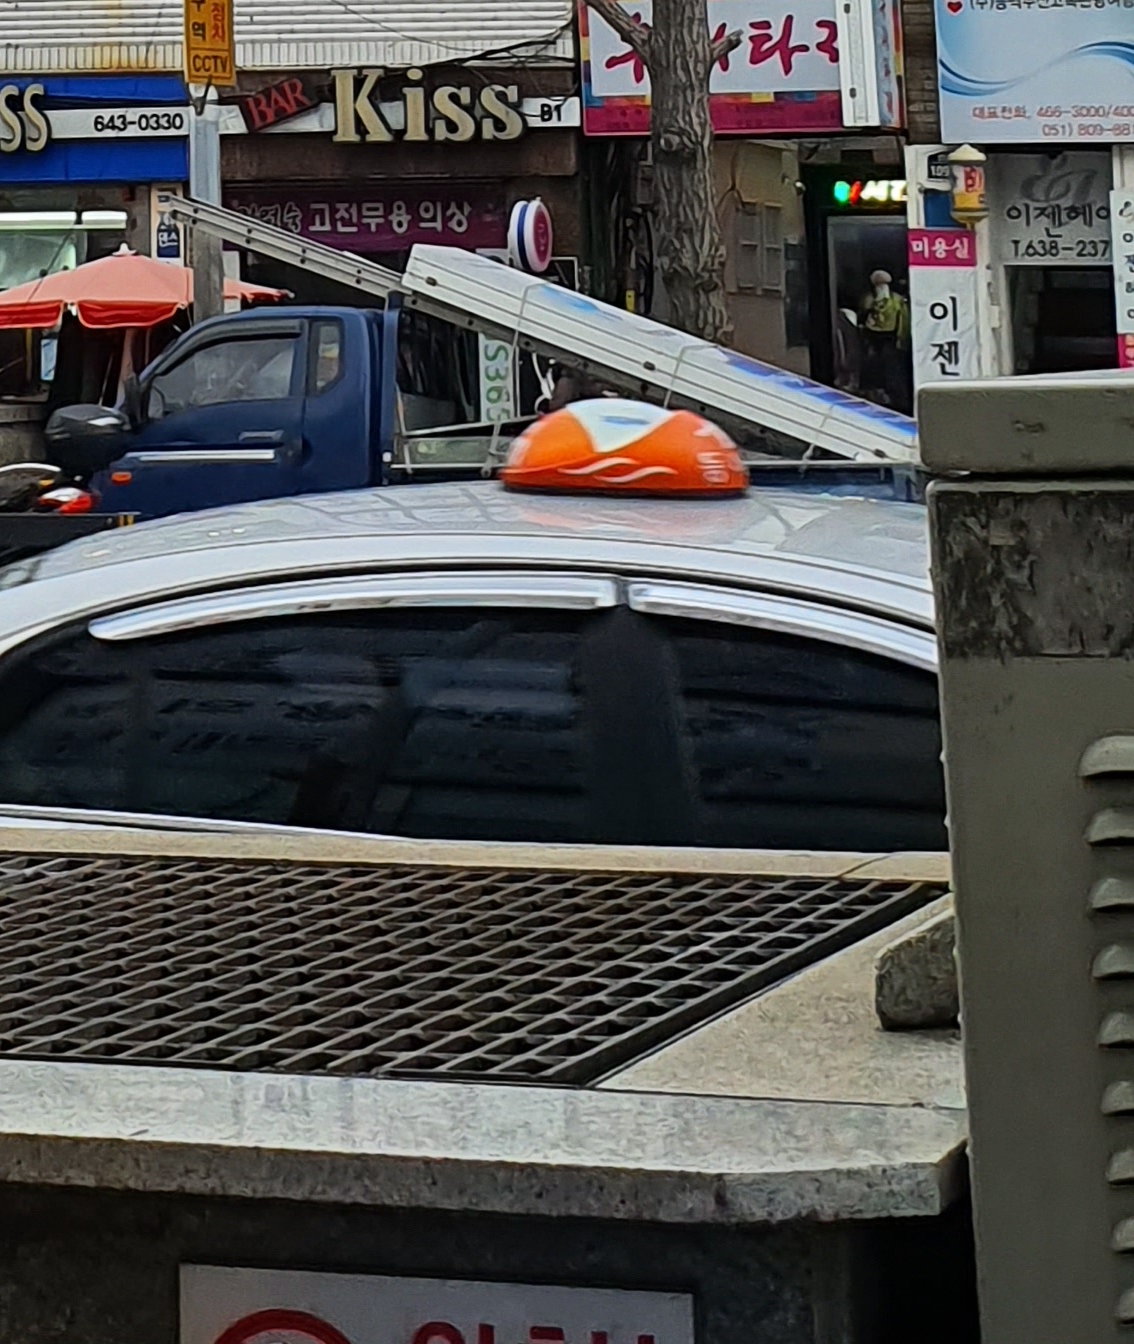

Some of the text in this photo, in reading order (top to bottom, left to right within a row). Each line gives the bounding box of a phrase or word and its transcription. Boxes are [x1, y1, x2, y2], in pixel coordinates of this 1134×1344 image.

[192, 54, 229, 74] CCTV
[246, 78, 312, 121] BAR
[331, 67, 524, 143] Kiss
[93, 113, 184, 132] 643-0330
[308, 199, 412, 234] 고전무용
[418, 199, 472, 233] 의상
[910, 237, 970, 259] 미용실
[929, 295, 960, 377] 이젠
